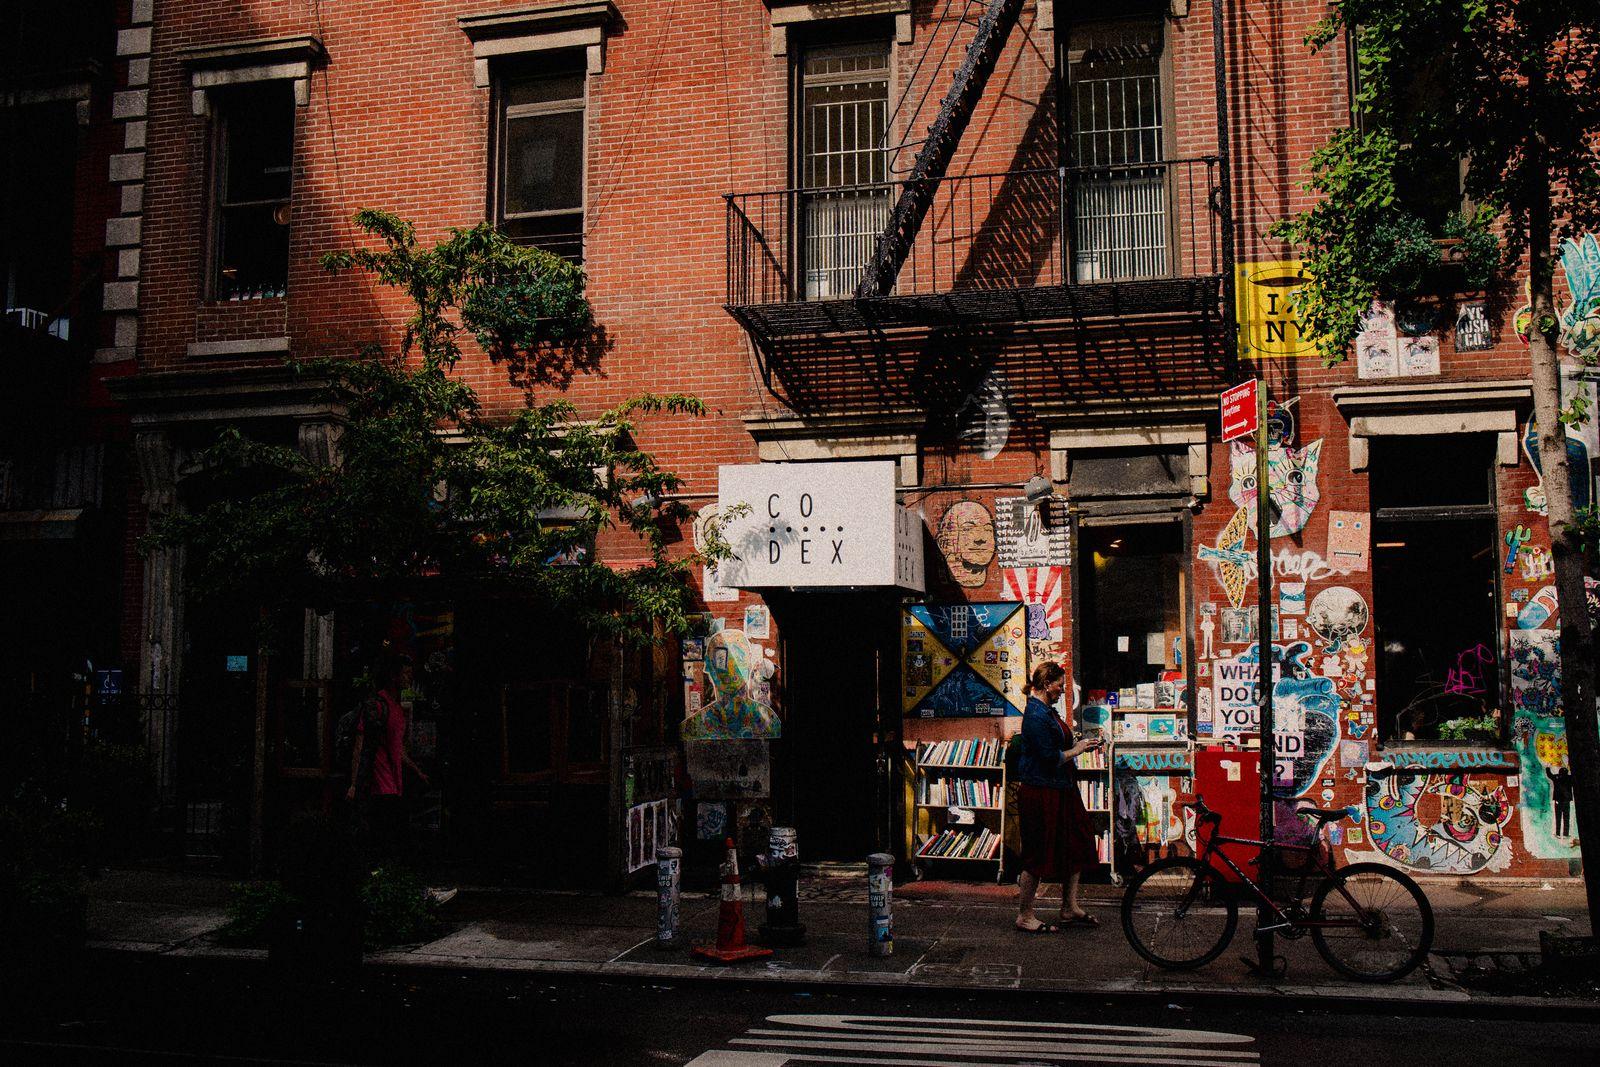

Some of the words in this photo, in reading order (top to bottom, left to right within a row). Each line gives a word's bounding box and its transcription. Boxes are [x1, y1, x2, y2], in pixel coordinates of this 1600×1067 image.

[1267, 293, 1279, 315] I
[1465, 306, 1485, 320] YC
[1265, 320, 1307, 343] NY
[1222, 396, 1230, 407] NO
[1229, 387, 1251, 404] STOPPING
[1223, 404, 1241, 418] Anytime
[769, 540, 843, 564] DEX
[1221, 687, 1249, 702] DO
[1221, 709, 1261, 725] YOU
